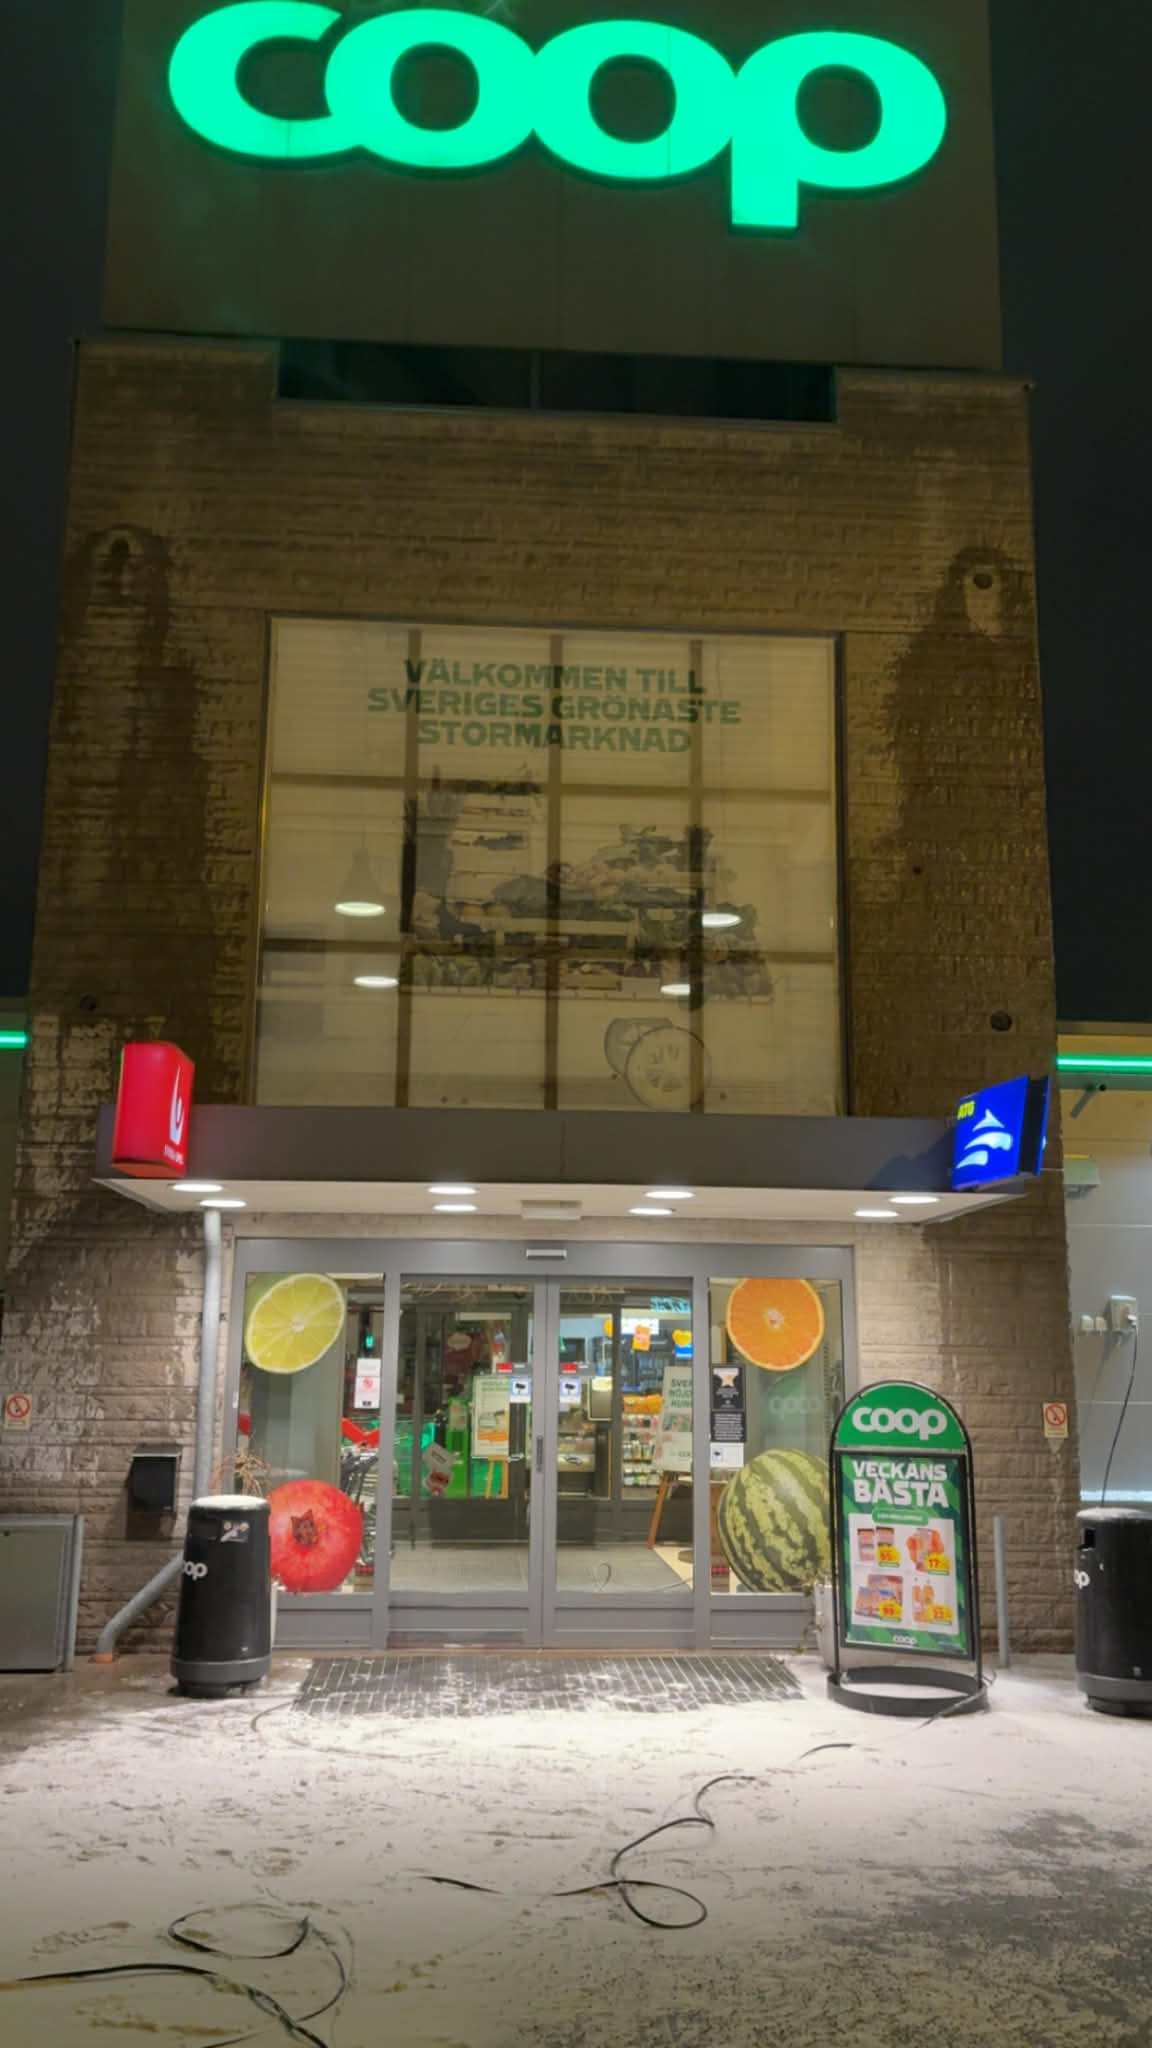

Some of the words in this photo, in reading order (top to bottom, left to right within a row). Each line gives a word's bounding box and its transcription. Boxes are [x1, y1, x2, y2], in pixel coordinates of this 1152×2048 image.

[168, 0, 947, 229] coop
[403, 659, 627, 691] VÄLKOMMEN
[635, 667, 706, 694] TILL
[367, 686, 544, 719] SVERIGES
[551, 694, 742, 725] GRÖNASTE
[418, 719, 692, 753] STORMARKNAD
[852, 1406, 948, 1441] coop
[852, 1460, 948, 1482] VECKANS
[853, 1475, 949, 1508] BÄSTA
